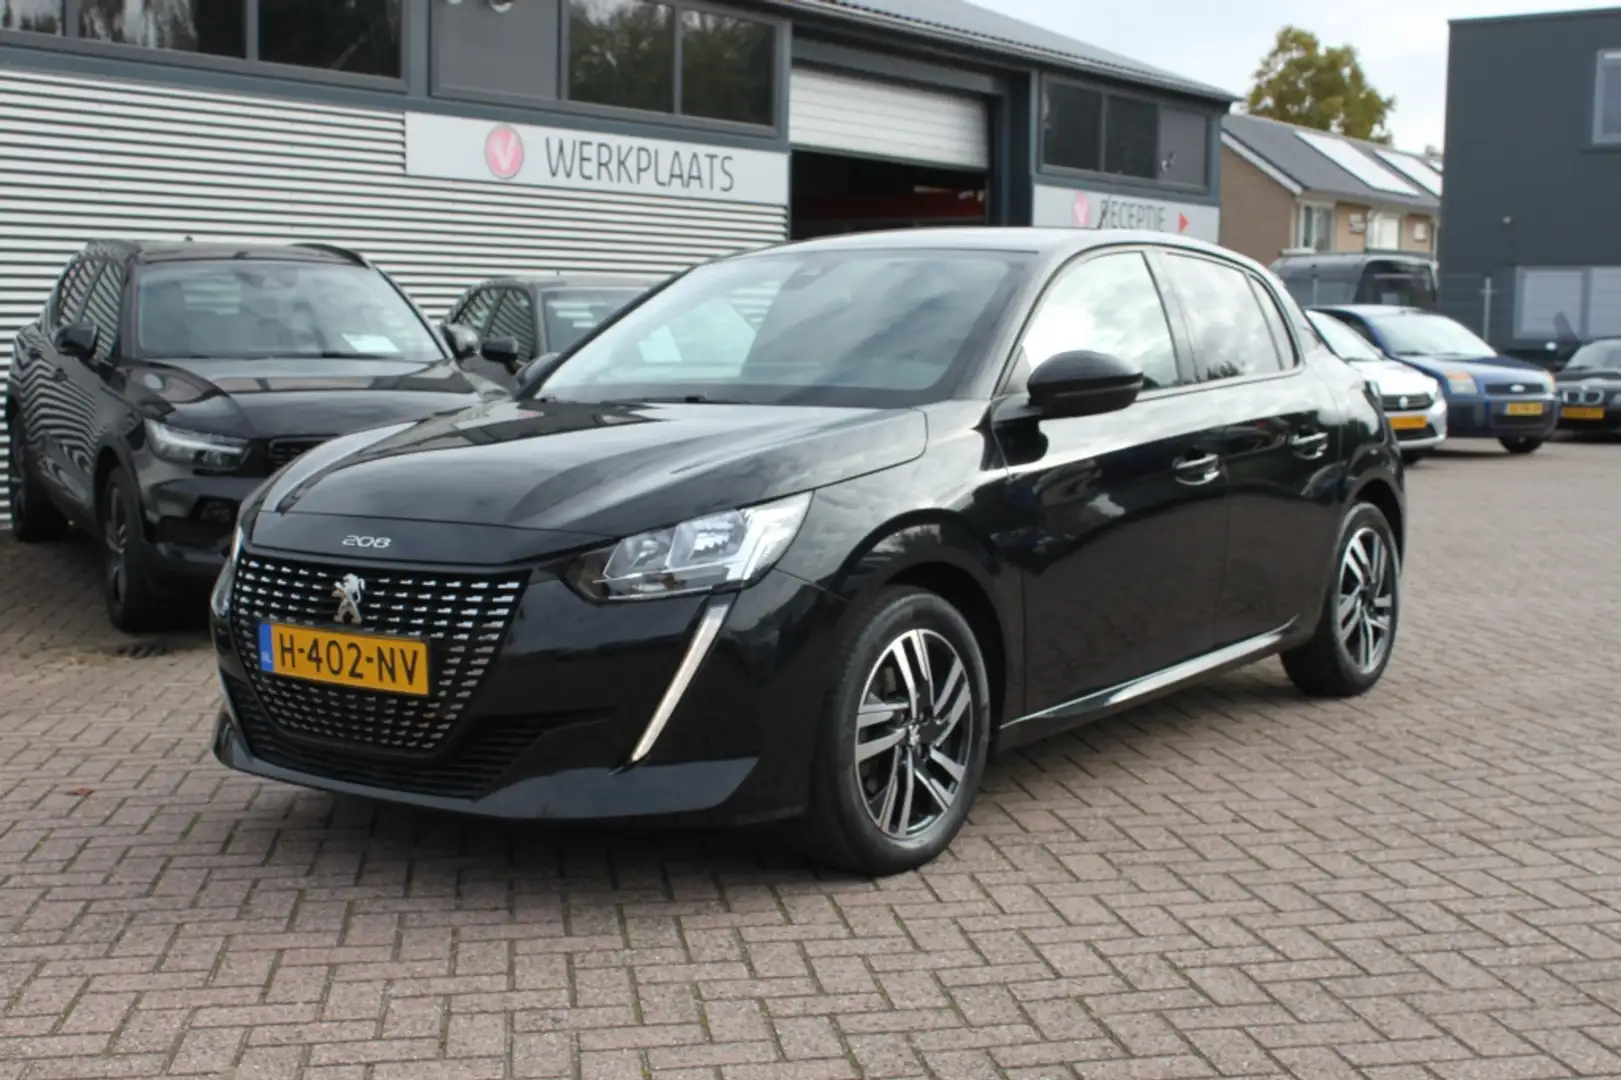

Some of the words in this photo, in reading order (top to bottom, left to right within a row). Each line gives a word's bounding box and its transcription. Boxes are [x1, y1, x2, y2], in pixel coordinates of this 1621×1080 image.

[545, 137, 735, 192] WERKPLAATS
[342, 535, 392, 549] 208
[279, 632, 418, 686] H-402-NV
